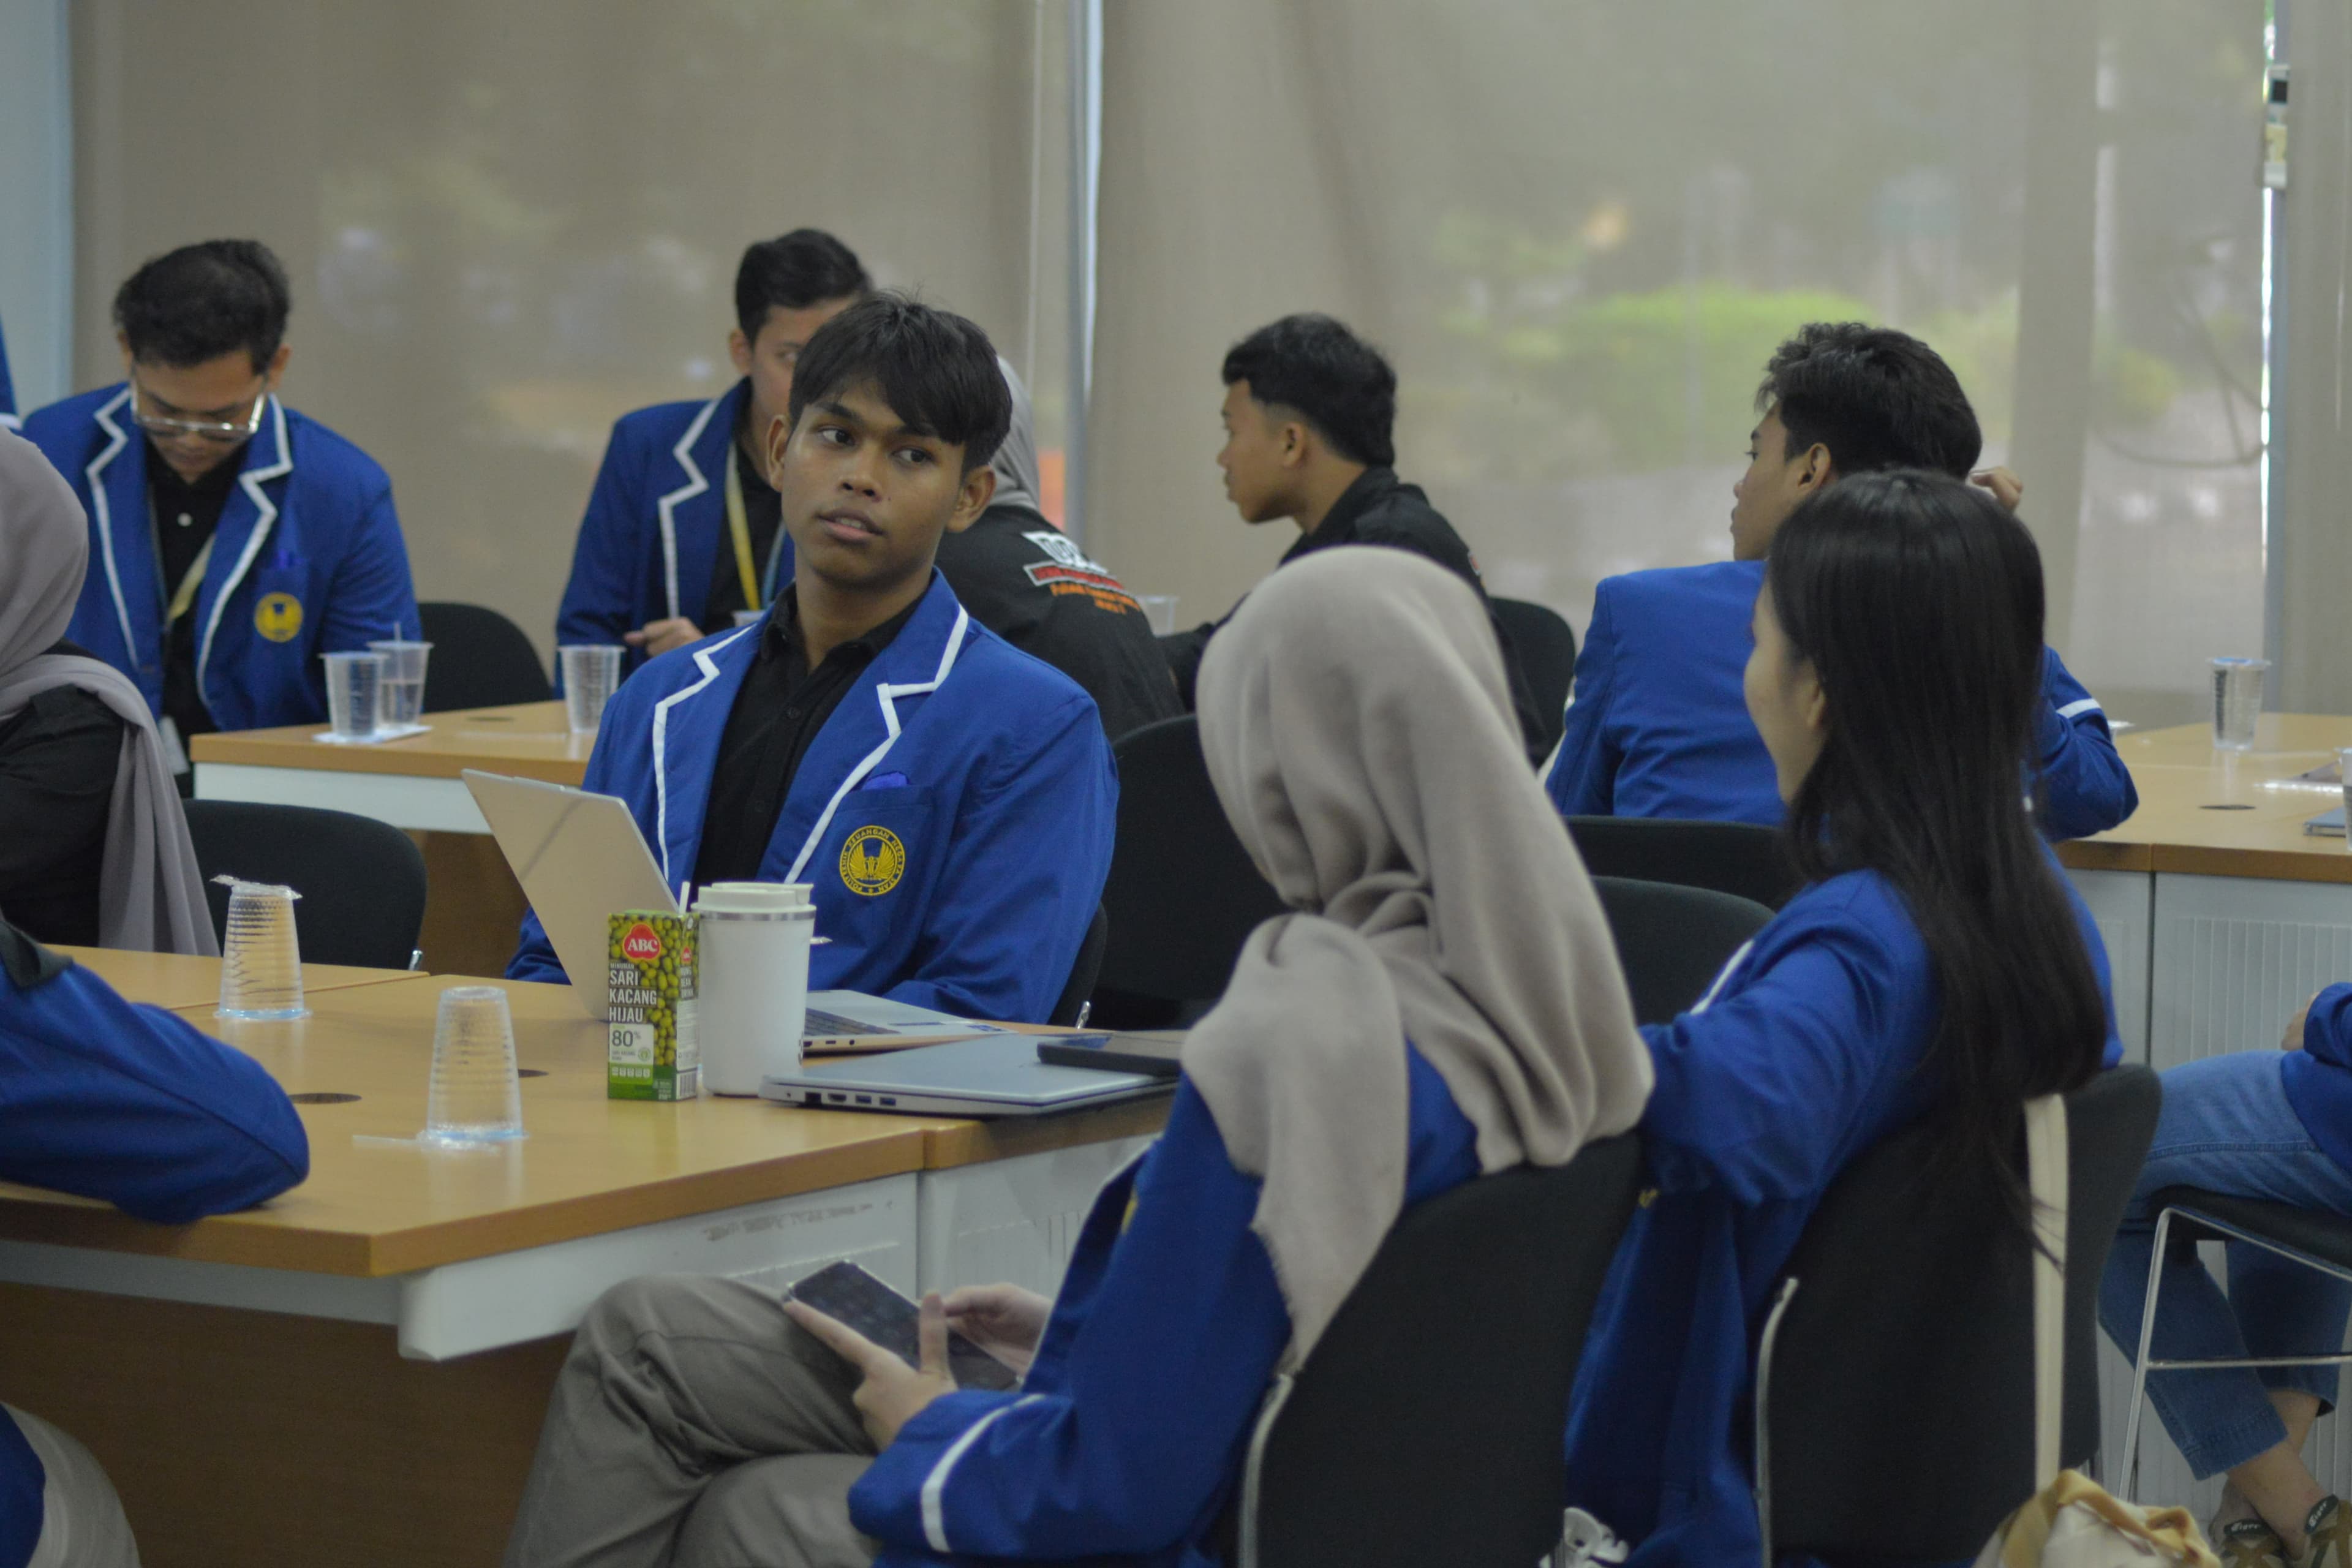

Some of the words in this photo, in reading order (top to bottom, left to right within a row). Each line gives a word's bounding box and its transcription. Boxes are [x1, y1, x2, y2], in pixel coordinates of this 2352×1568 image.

[627, 938, 658, 952] ABC
[610, 970, 638, 986] SARI
[609, 988, 657, 1005] KACANG
[609, 1006, 643, 1022] HIJAU
